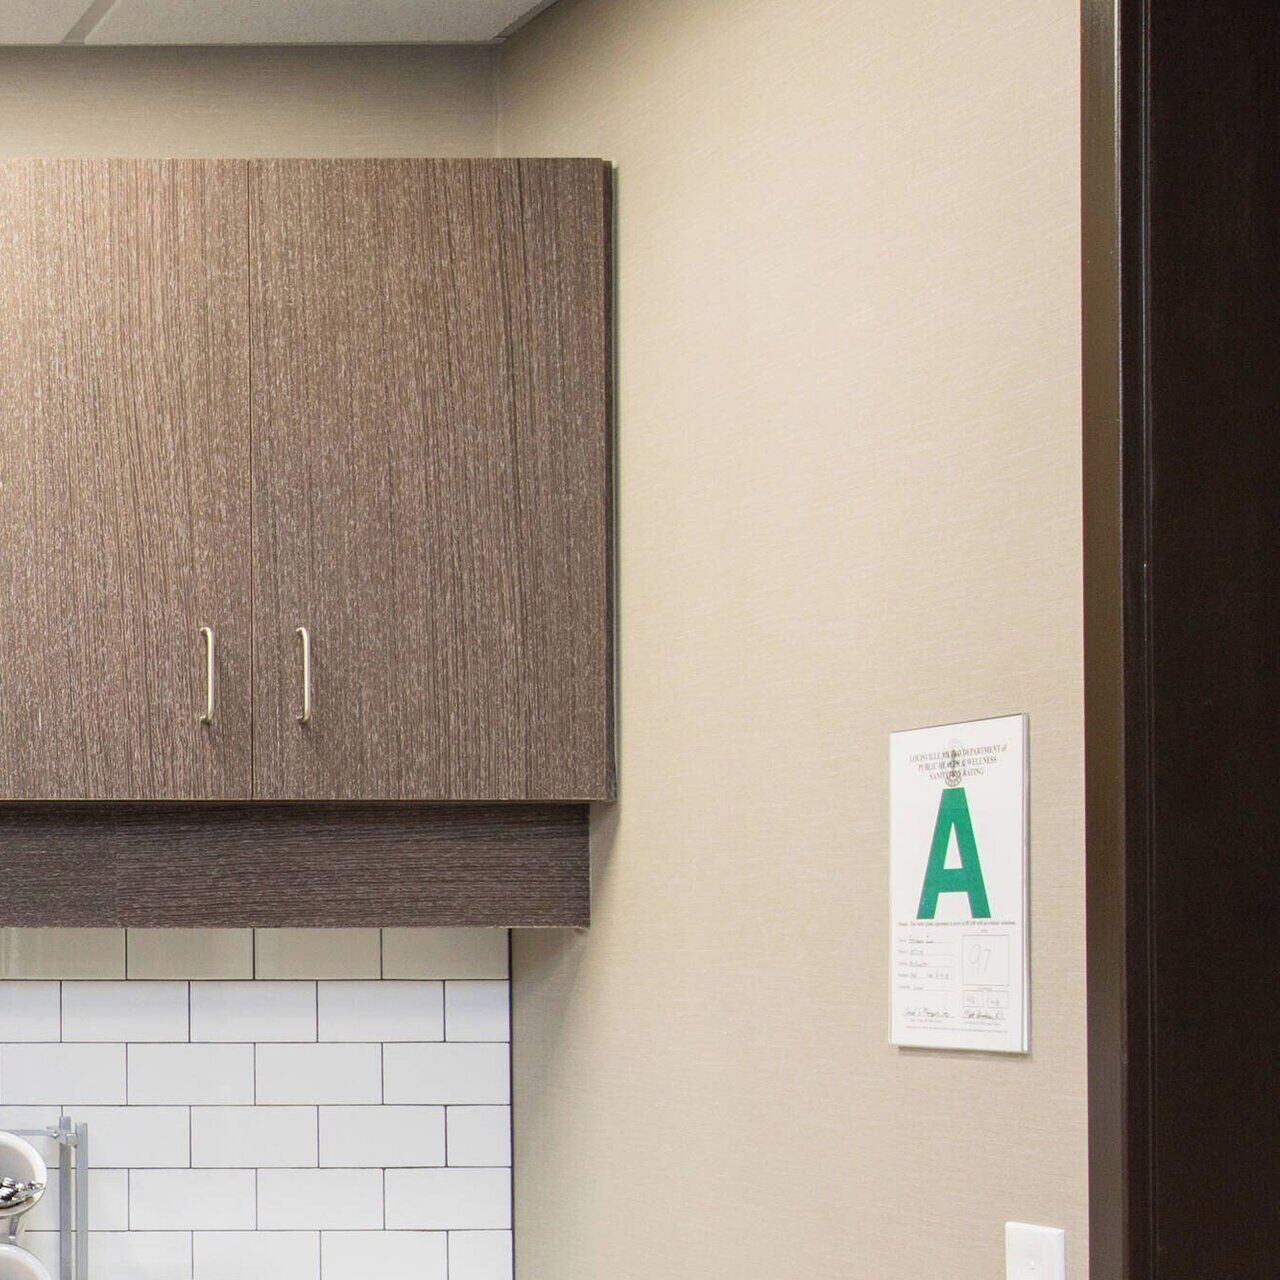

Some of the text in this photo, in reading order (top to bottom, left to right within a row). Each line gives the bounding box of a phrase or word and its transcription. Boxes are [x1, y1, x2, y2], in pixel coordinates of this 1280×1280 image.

[962, 745, 1001, 756] DEPARTMENT
[918, 763, 937, 772] PUBLIC
[966, 756, 998, 766] WELLNESS
[961, 767, 984, 777] RATING
[917, 787, 992, 920] A
